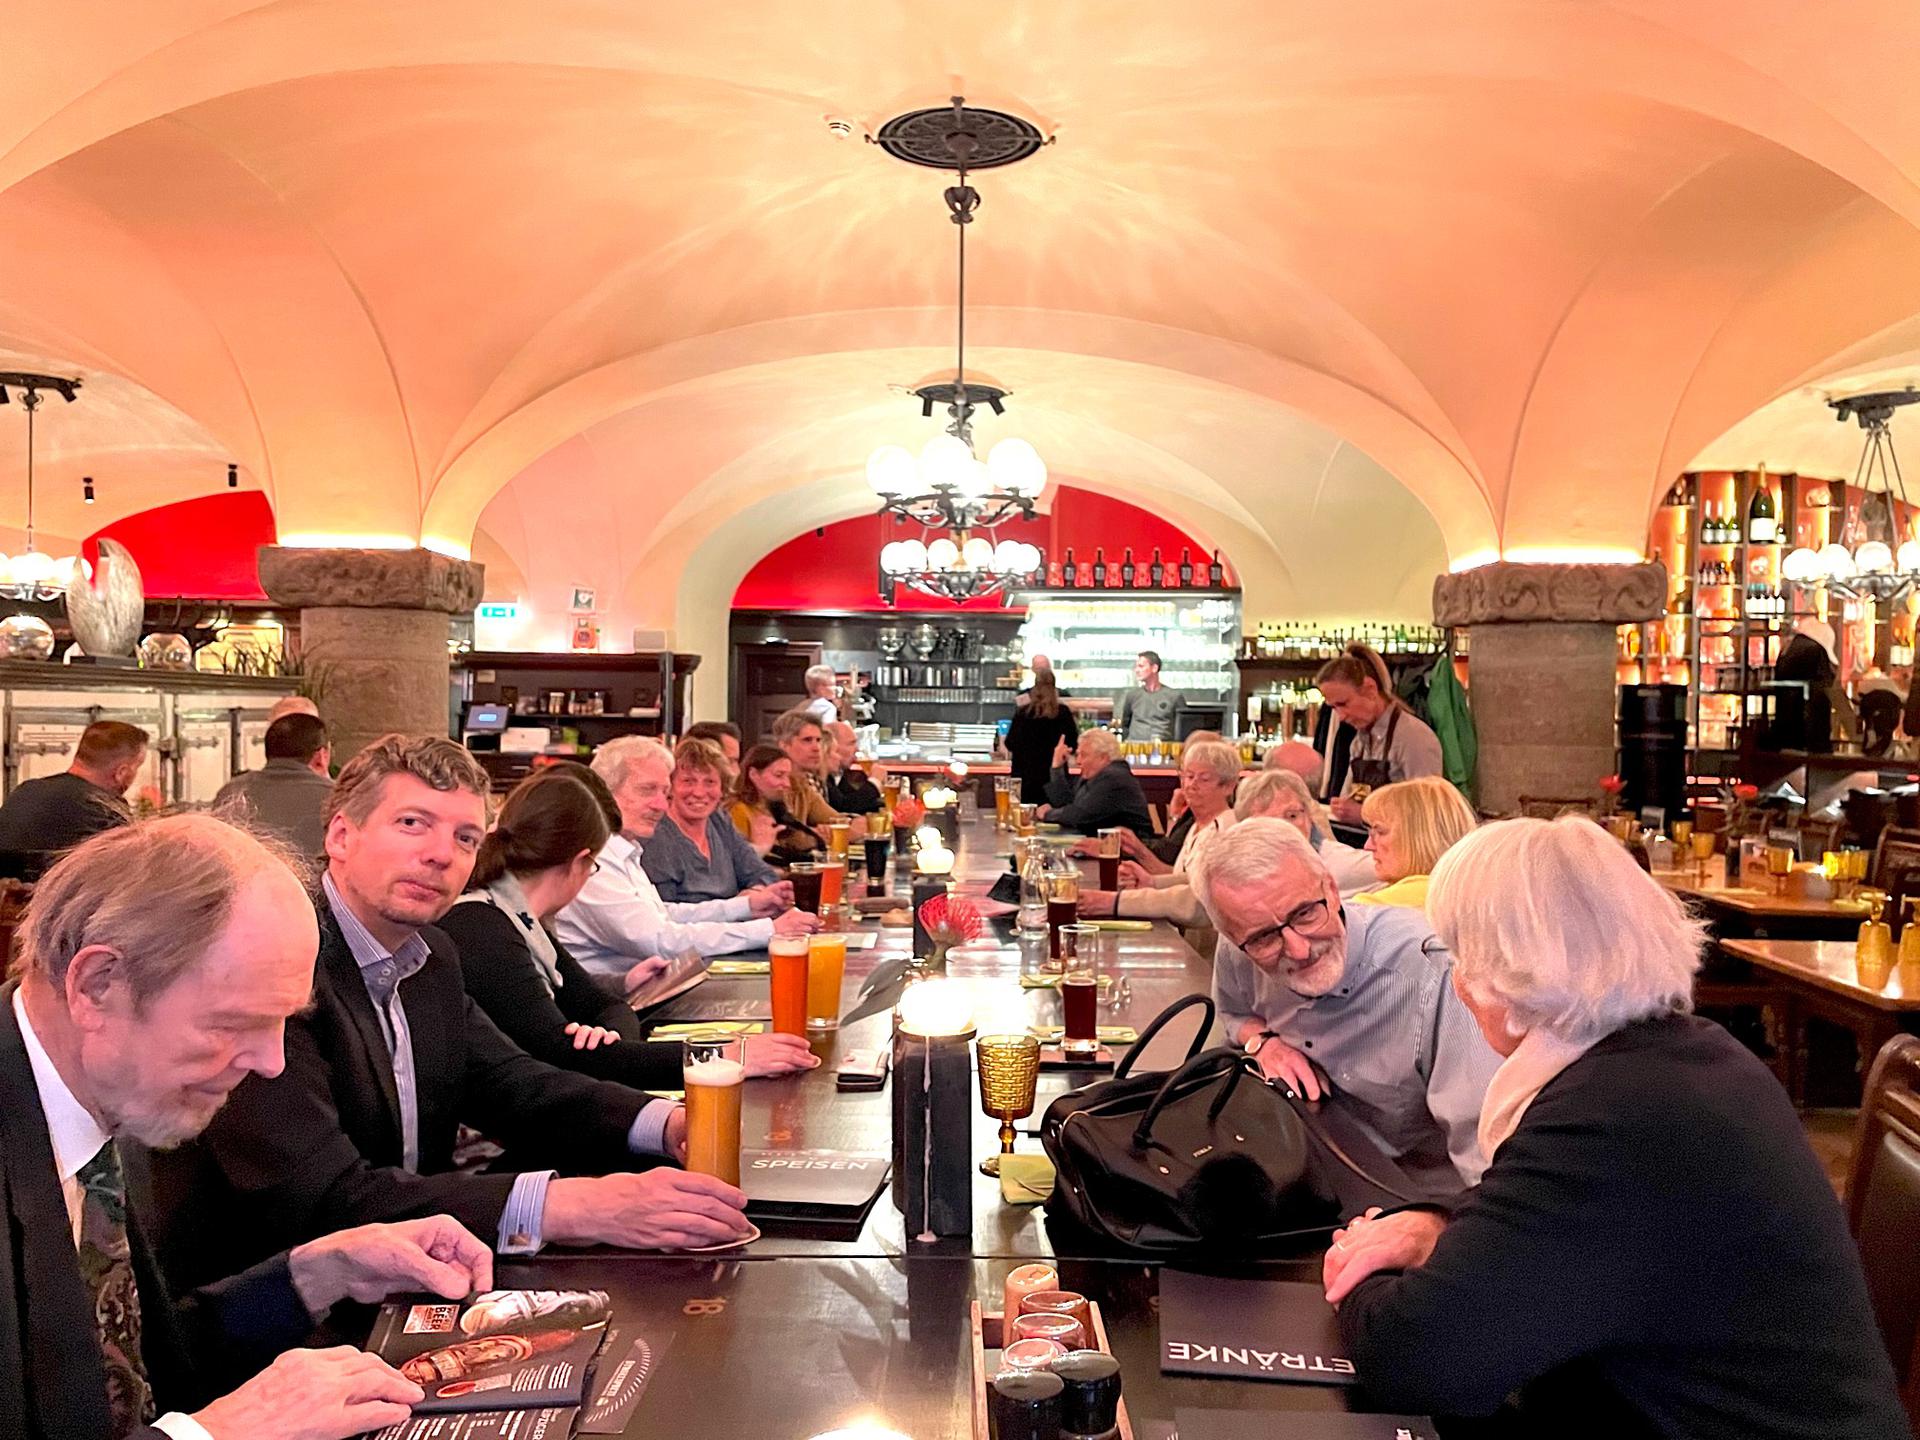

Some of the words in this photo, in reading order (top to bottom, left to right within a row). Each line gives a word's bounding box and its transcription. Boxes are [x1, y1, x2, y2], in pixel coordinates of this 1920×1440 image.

[751, 1158, 869, 1171] SPEISEN
[431, 1307, 446, 1330] BEER
[1167, 1342, 1358, 1375] ETRÄNKE
